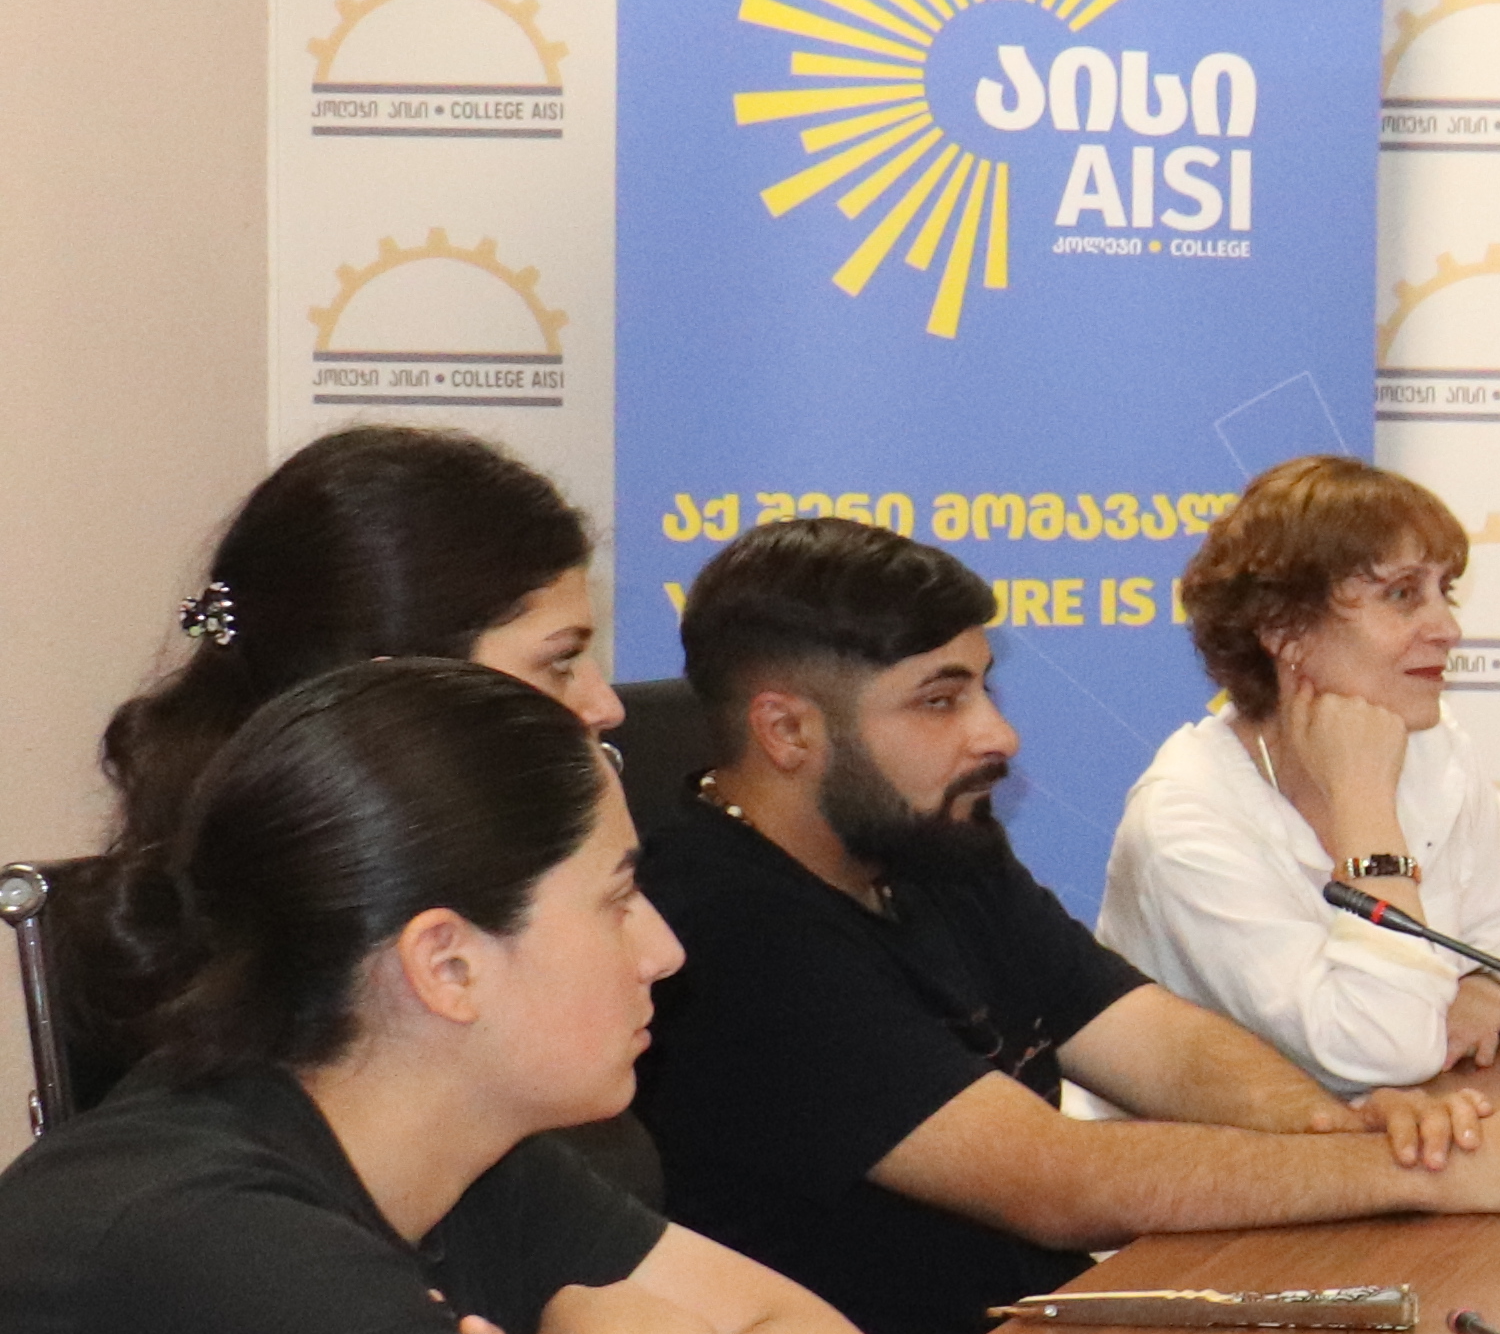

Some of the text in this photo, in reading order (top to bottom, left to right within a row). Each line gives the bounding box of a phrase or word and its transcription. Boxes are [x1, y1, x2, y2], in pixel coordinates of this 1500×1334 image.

[450, 102, 524, 119] COLLEGE
[531, 103, 564, 119] AISI
[1055, 144, 1252, 232] AISI
[1169, 238, 1250, 258] COLLEGE
[451, 370, 524, 387] COLLEGE
[531, 371, 564, 388] AISI
[1101, 577, 1156, 626] IS
